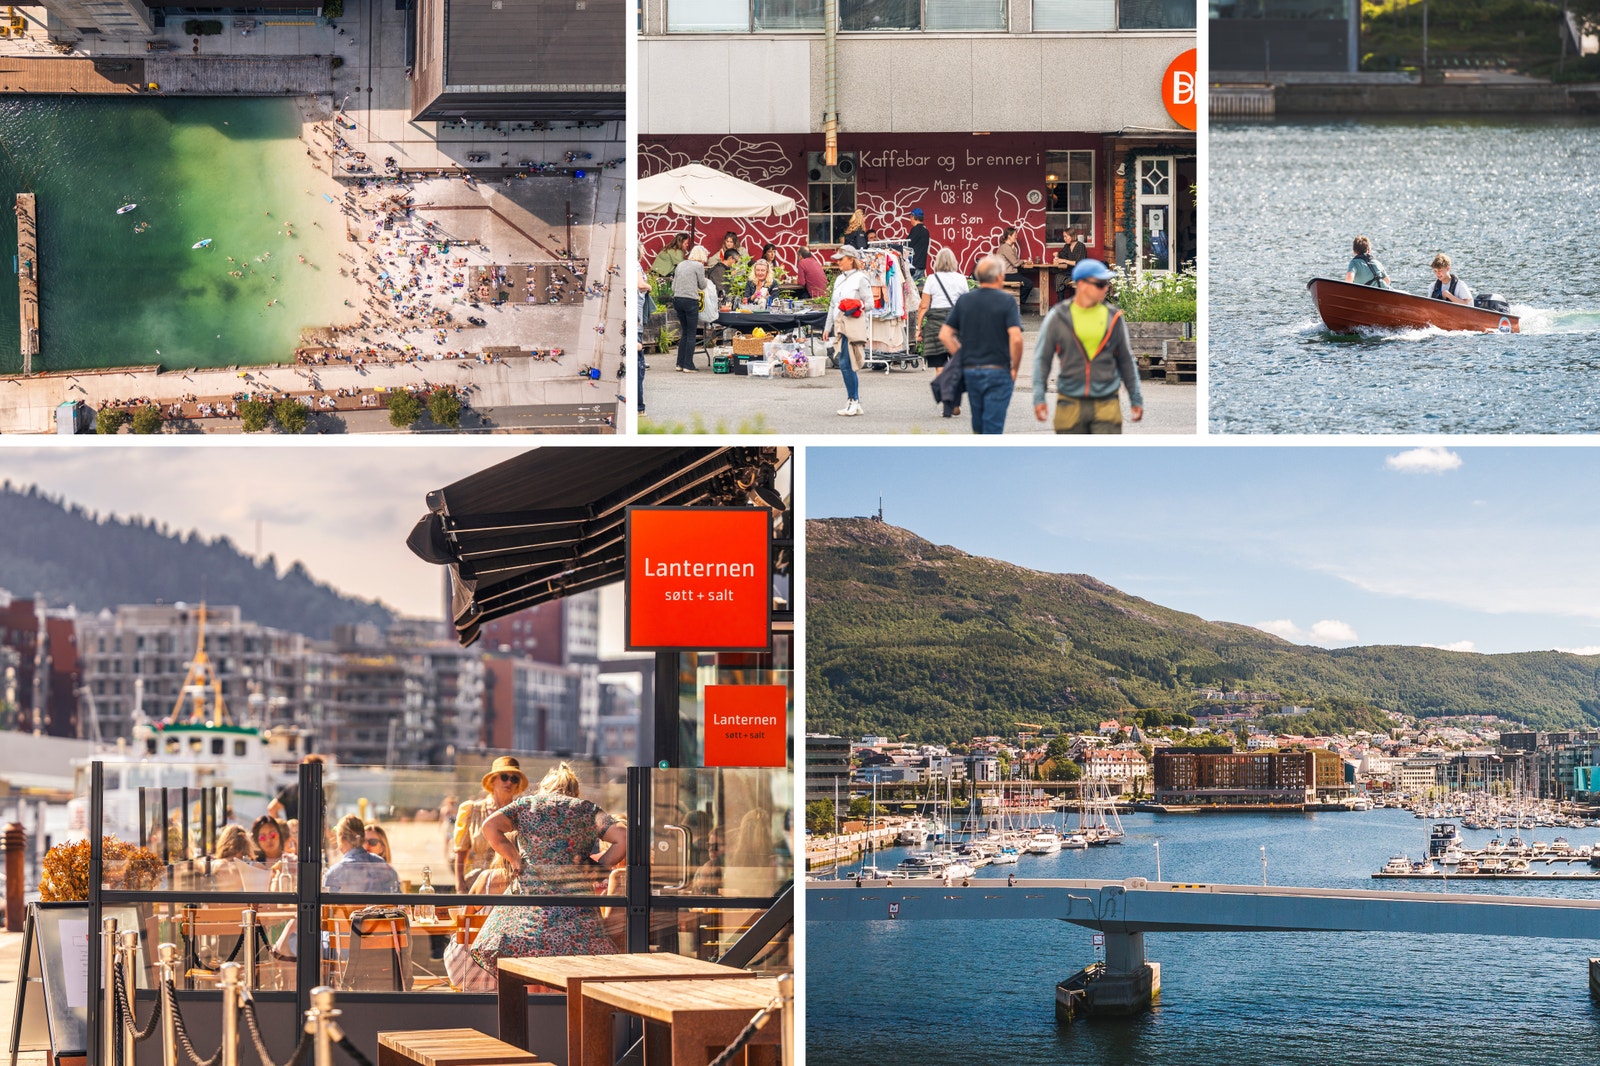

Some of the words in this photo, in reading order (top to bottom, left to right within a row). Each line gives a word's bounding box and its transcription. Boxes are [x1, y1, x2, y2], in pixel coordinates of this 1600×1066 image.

[1173, 71, 1196, 105] B
[859, 149, 931, 168] Kaffebar
[937, 155, 955, 172] og
[644, 557, 754, 577] Lanternen
[665, 589, 694, 601] søtt
[696, 591, 705, 600] +
[708, 588, 734, 601] salt
[713, 713, 777, 726] Lanternen
[749, 731, 765, 739] salt
